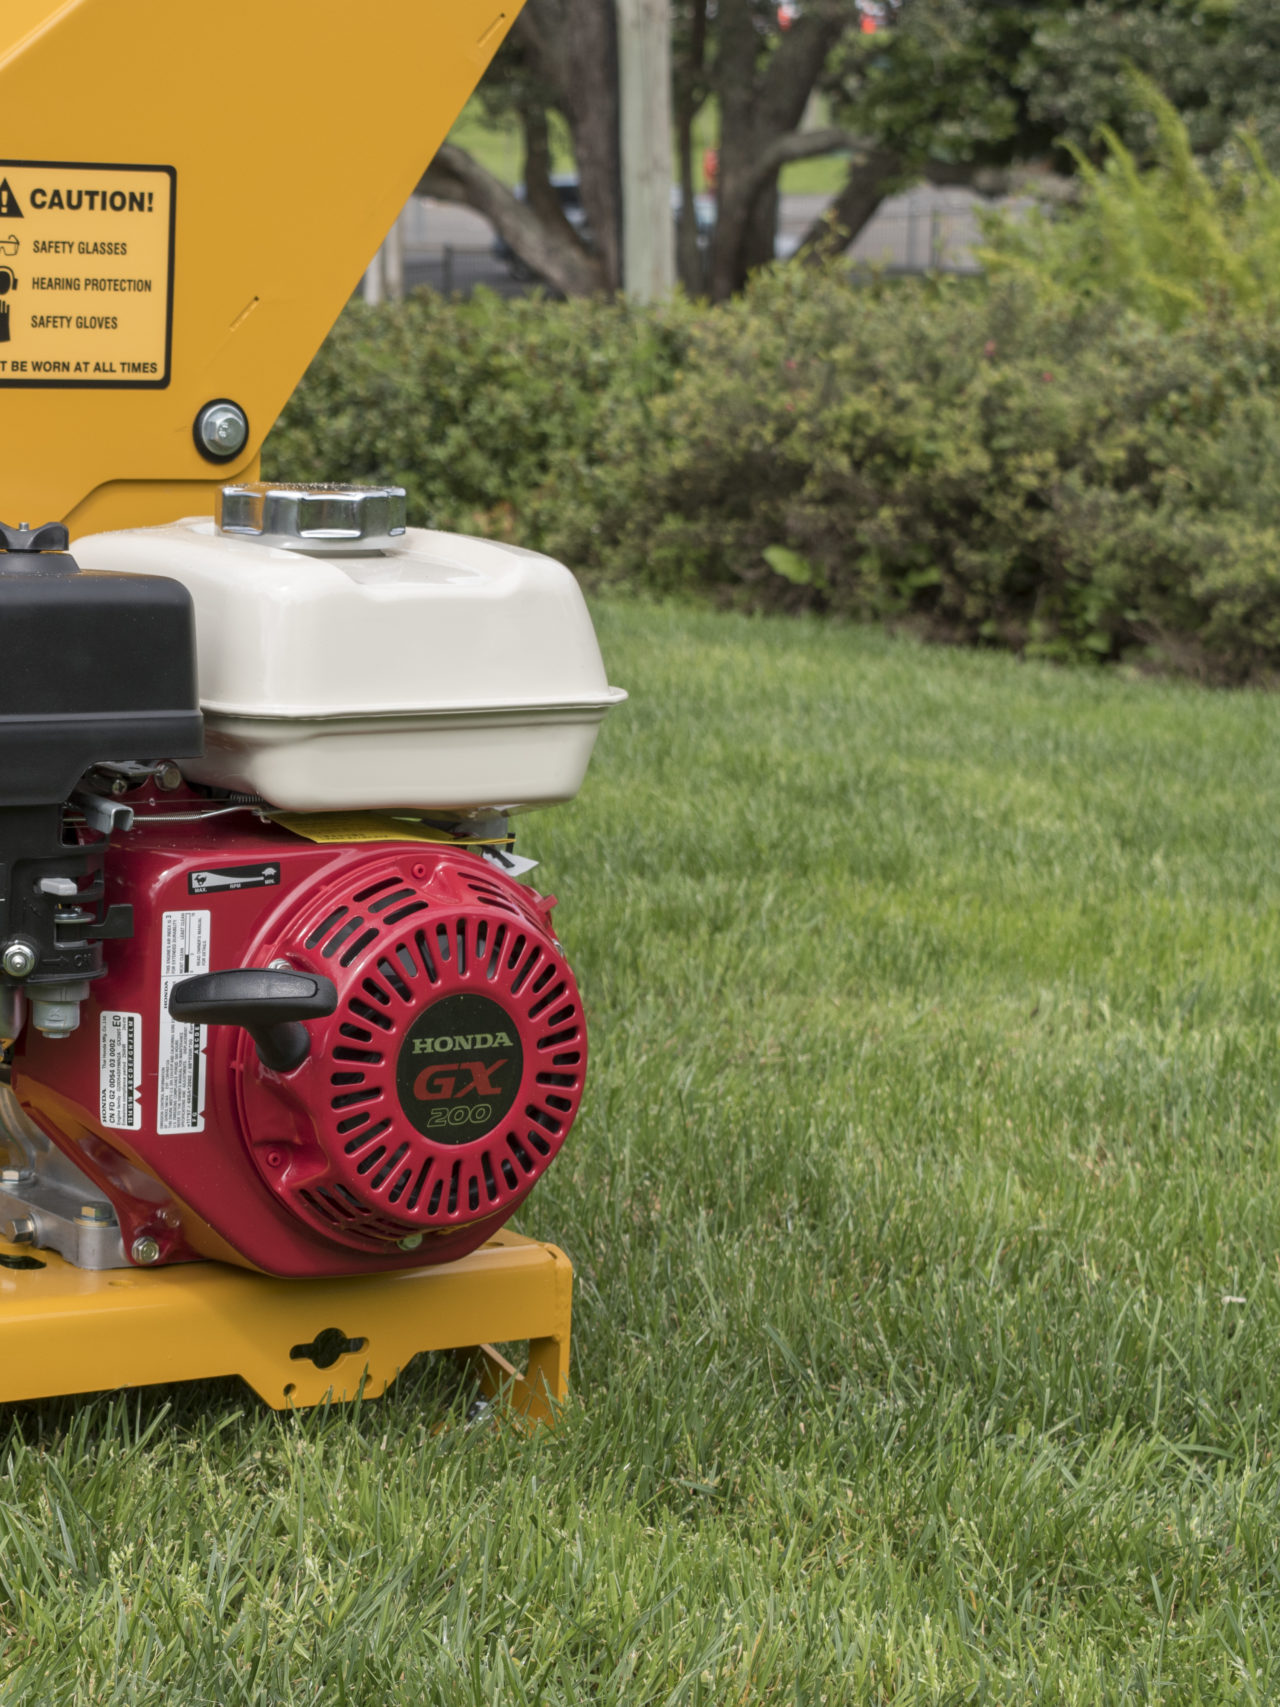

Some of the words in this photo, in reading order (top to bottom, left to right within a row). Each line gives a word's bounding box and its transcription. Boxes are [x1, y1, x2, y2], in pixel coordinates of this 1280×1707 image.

[29, 188, 154, 212] CAUTION!
[32, 240, 74, 254] SAFETY
[78, 241, 127, 255] GLASSES
[32, 277, 80, 291] HEARING
[84, 278, 152, 292] PROTECTION
[31, 315, 72, 328] SAFETY
[75, 316, 118, 329] GLOVES
[11, 361, 27, 372] BE
[31, 361, 70, 372] WORN
[74, 361, 89, 372] AT
[93, 362, 116, 373] ALL
[120, 362, 158, 373] TIMES
[412, 1032, 513, 1054] HONDA
[109, 1059, 115, 1068] 03
[413, 1059, 509, 1100] GX
[109, 1090, 115, 1100] G2
[109, 1101, 115, 1111] FD
[109, 1113, 115, 1123] CN
[426, 1104, 492, 1128] 200
